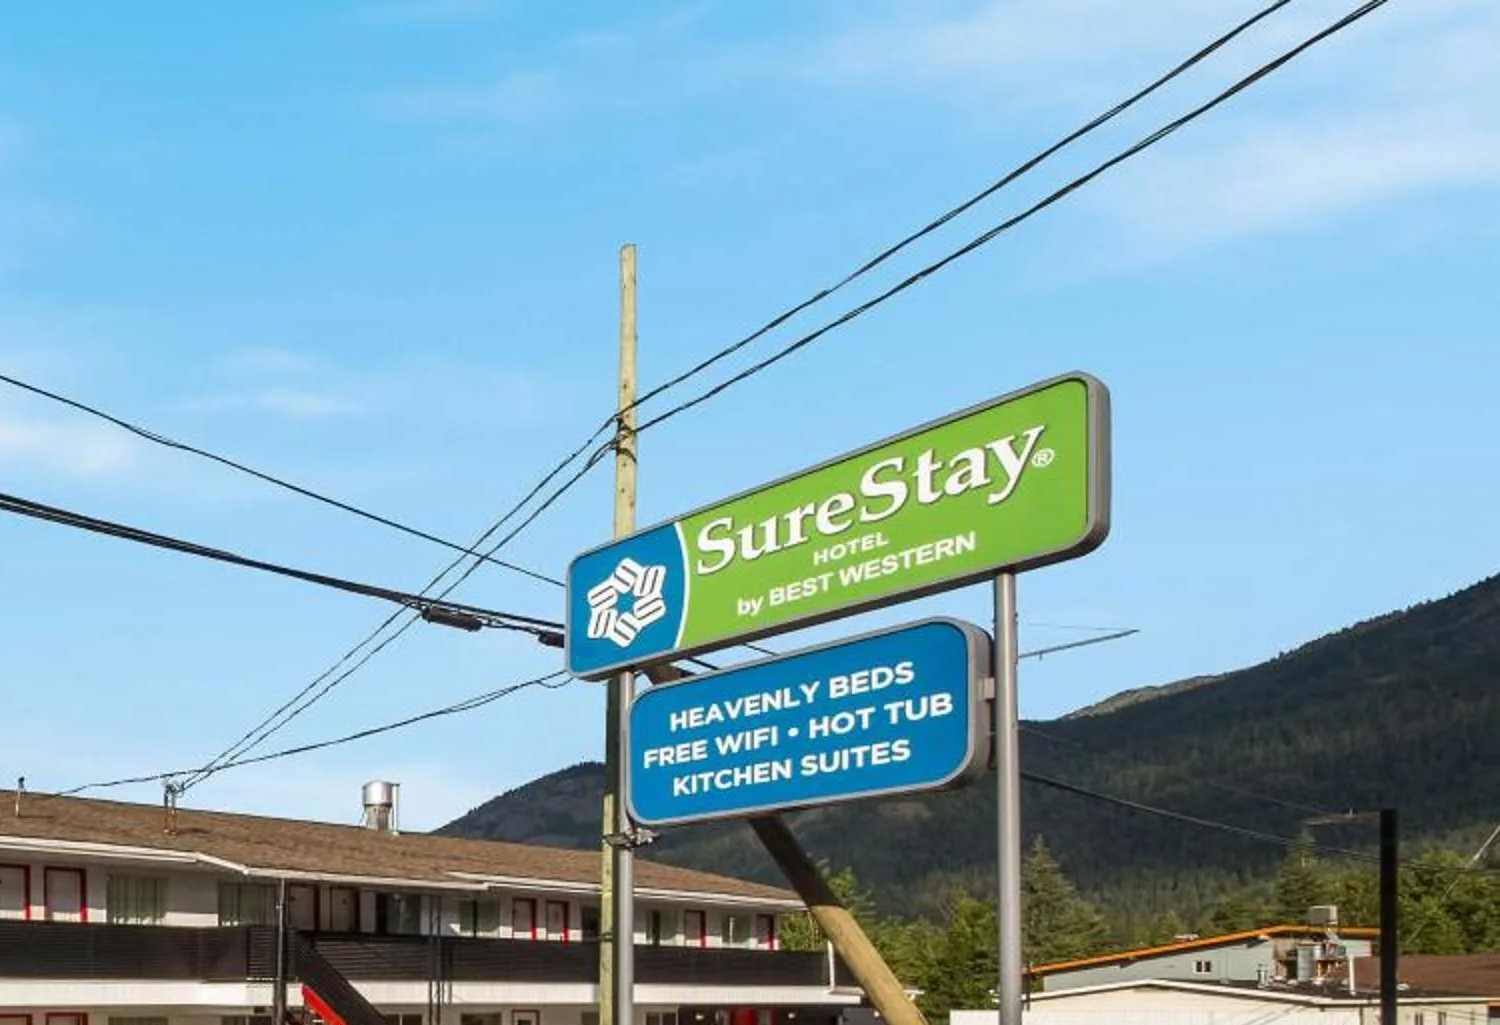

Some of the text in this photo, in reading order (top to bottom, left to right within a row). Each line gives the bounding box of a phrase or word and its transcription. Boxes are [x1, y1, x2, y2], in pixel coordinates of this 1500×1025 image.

[737, 531, 976, 617] by BEST WESTERN
[813, 532, 889, 565] HOTEL
[643, 692, 954, 769] FREE WIFI HOT TUB
[670, 661, 915, 732] HEAVENLY BEDS
[673, 739, 912, 797] KITCHEN SUITES
